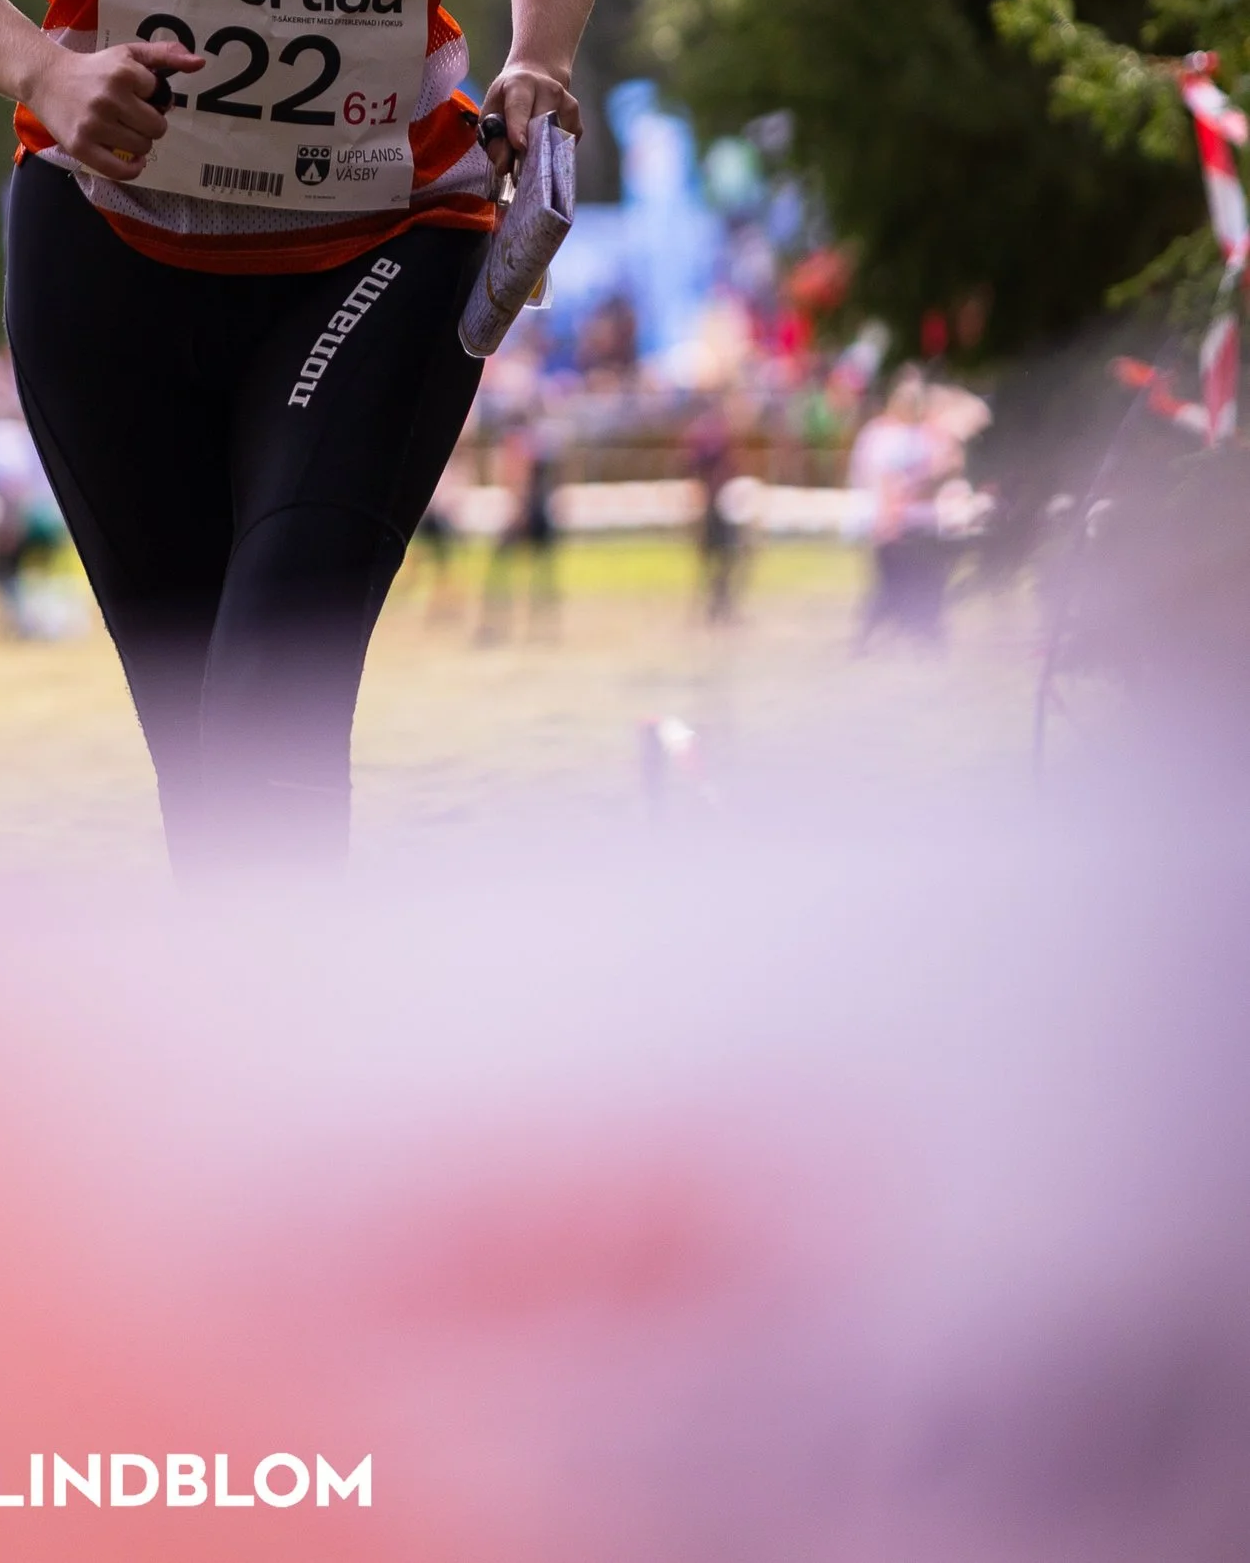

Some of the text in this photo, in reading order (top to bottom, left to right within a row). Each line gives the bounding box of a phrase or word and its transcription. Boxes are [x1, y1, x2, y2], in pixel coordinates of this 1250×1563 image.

[316, 17, 334, 26] MED
[381, 20, 404, 28] FOKUS
[343, 91, 397, 125] 6:1
[337, 147, 404, 164] UPPLANDS
[336, 165, 379, 181] VÄSBY
[287, 256, 401, 409] noname
